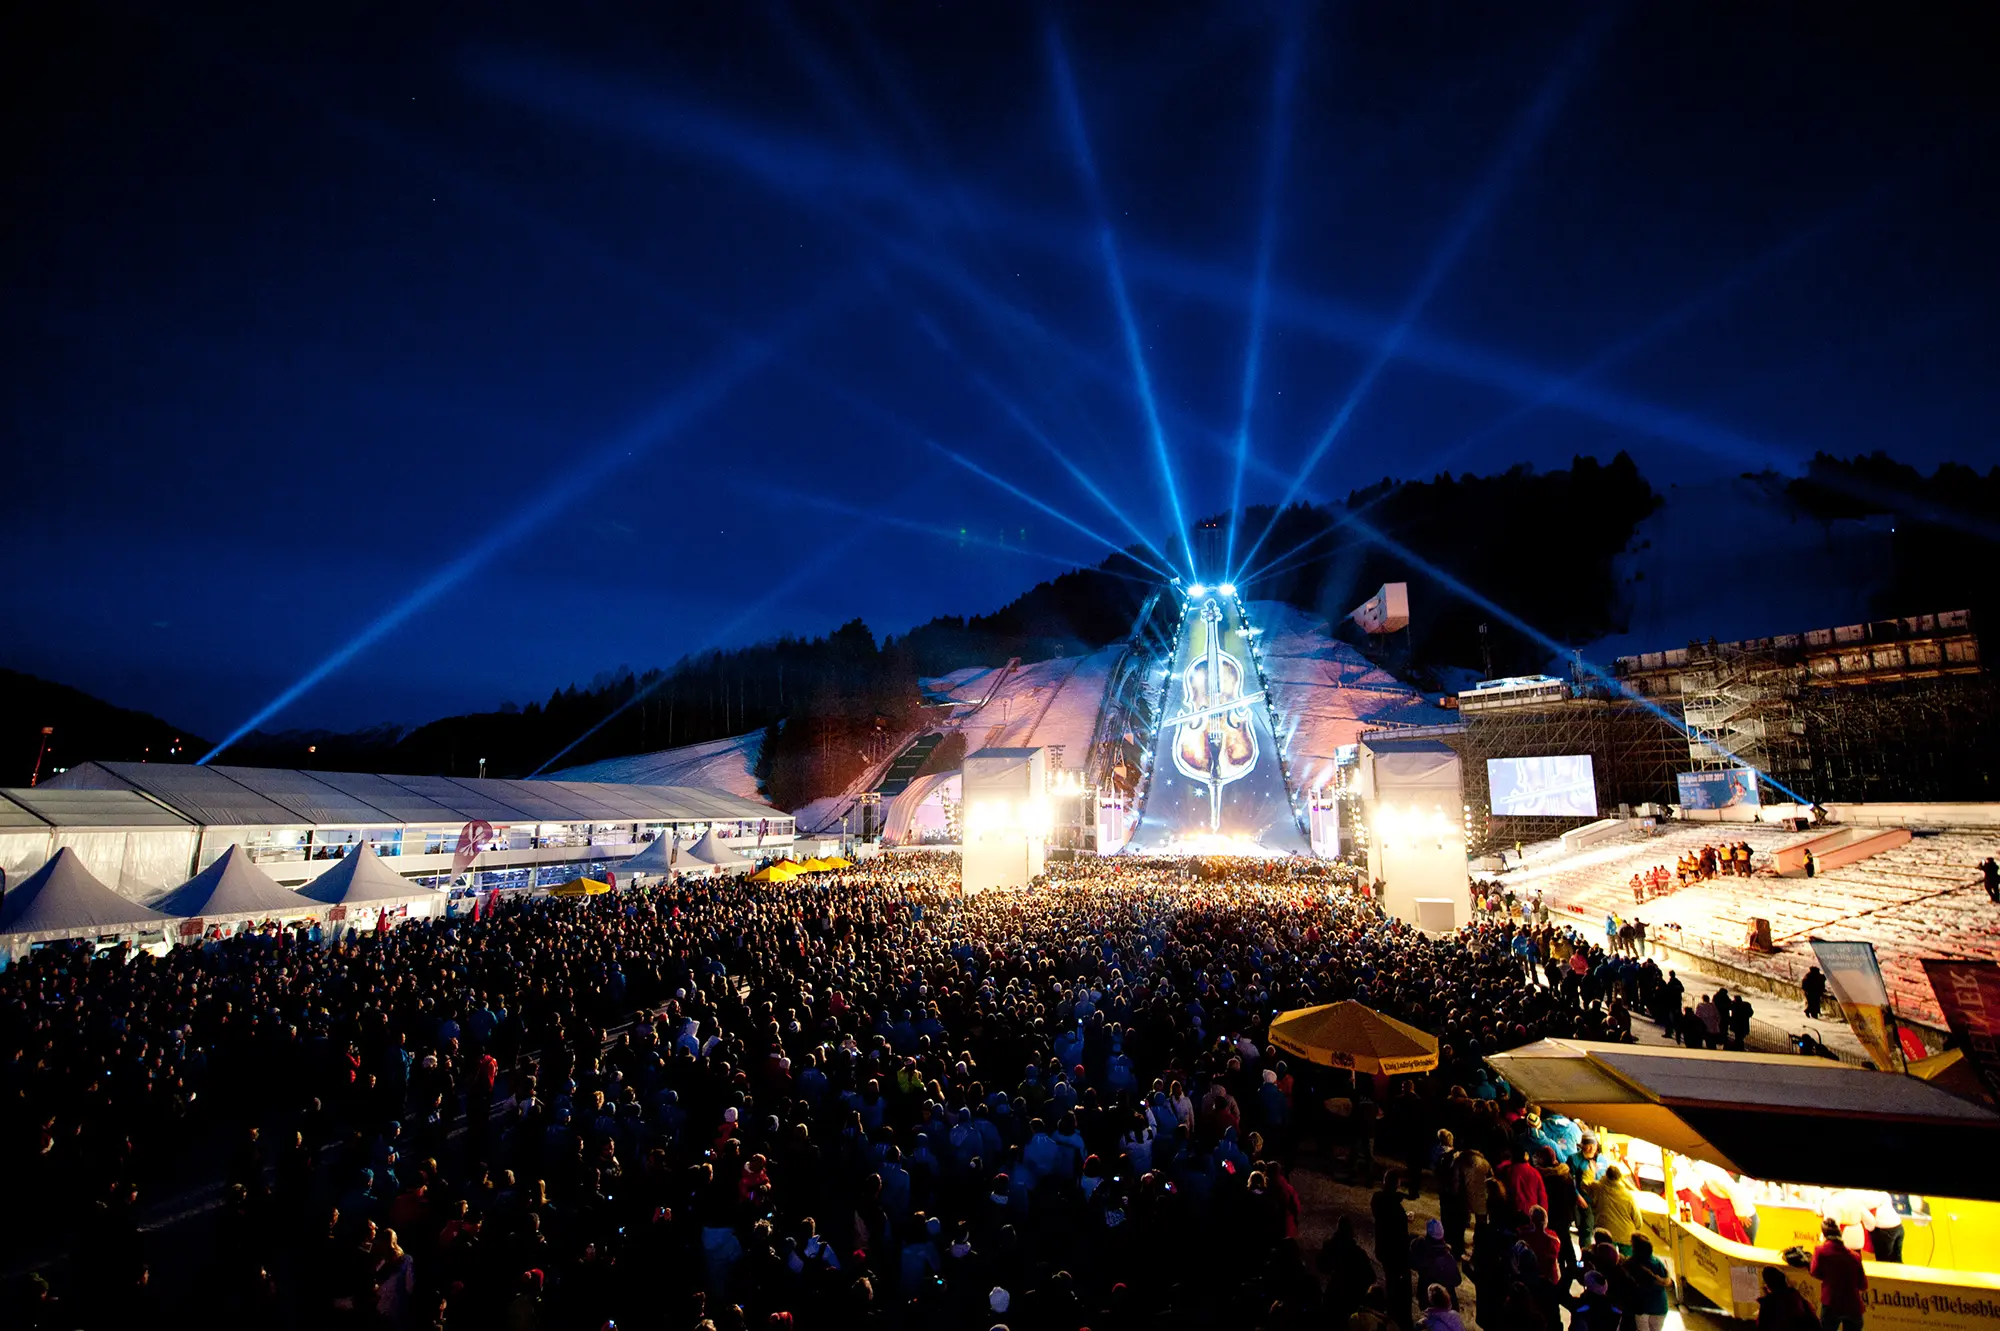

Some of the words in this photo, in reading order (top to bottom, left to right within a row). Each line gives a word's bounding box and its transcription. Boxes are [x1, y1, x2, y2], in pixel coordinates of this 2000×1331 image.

[1714, 773, 1725, 781] 2011
[1794, 1231, 1814, 1243] König
[1871, 1288, 1930, 1315] Ludwig
